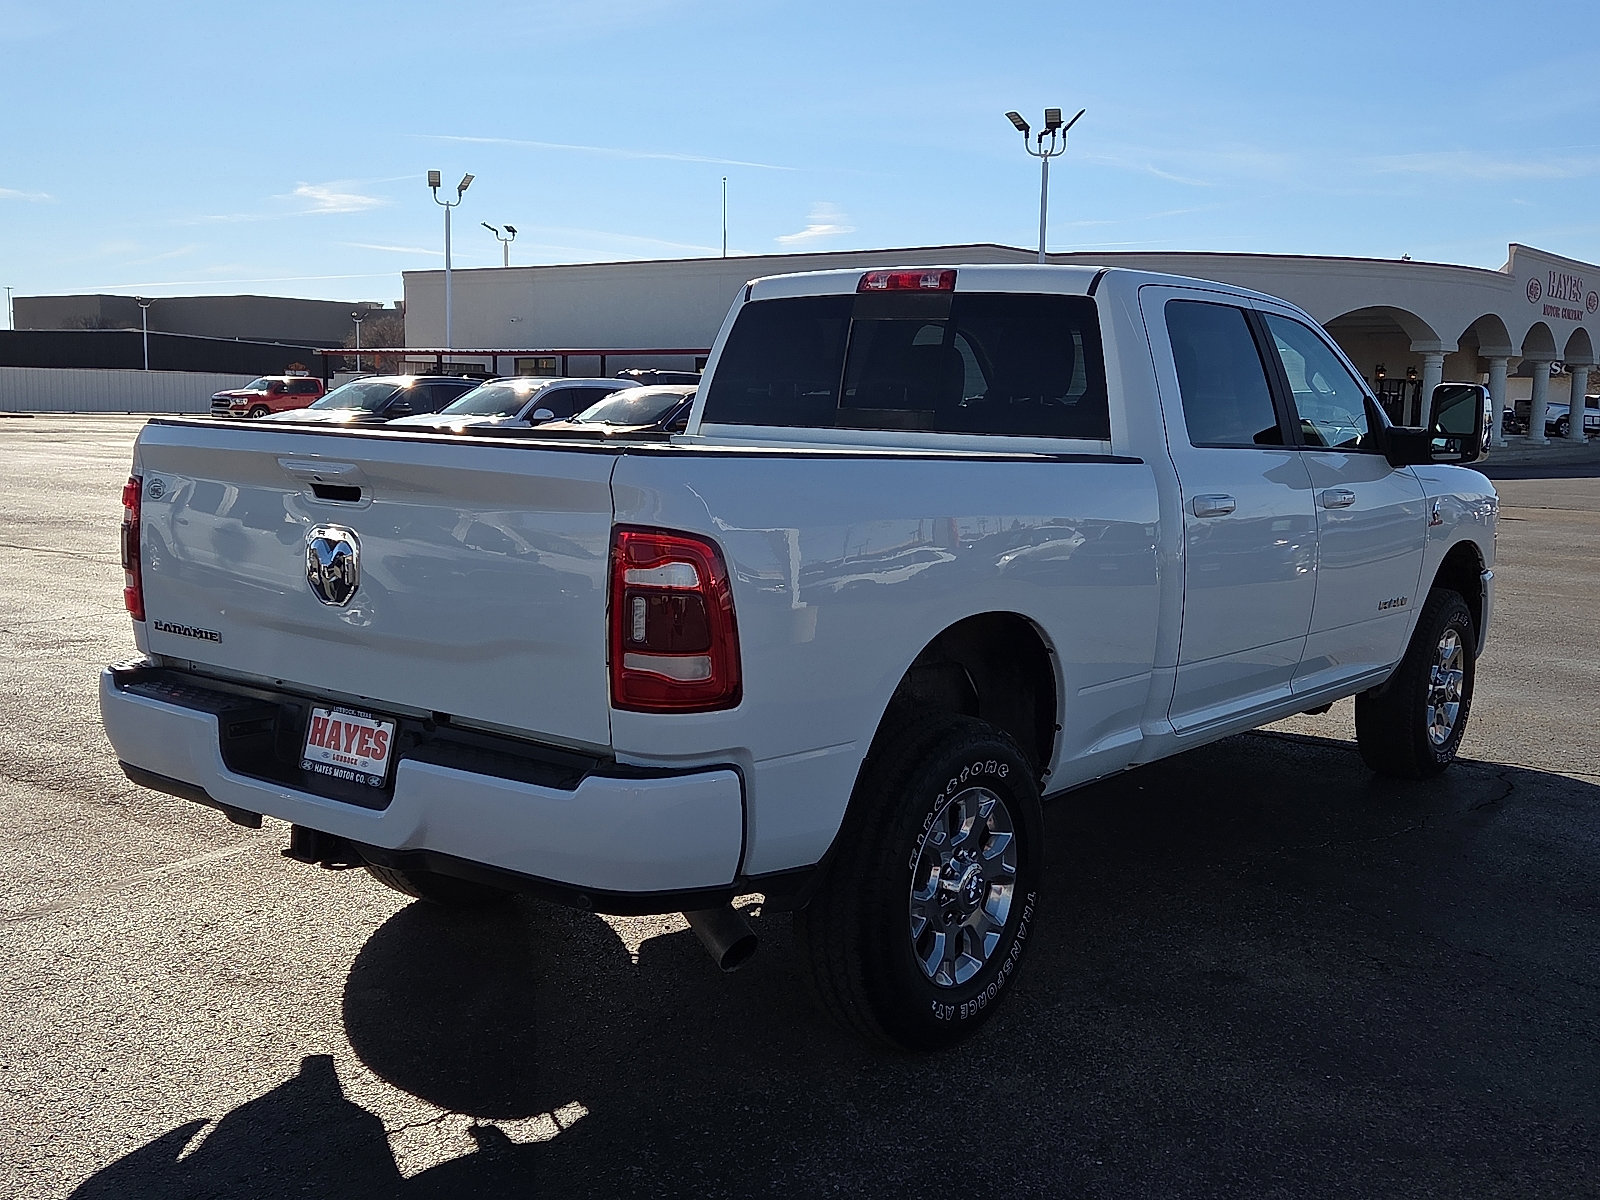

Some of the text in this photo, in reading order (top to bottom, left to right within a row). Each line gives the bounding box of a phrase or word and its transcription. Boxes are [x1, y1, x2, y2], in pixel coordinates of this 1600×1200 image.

[1547, 270, 1583, 302] HAYES
[153, 619, 222, 643] LARAMIE
[357, 711, 372, 719] TEXAS
[308, 716, 389, 761] HAYES
[332, 753, 359, 766] LUBBOCK
[314, 763, 333, 775] HAYES
[333, 768, 354, 781] MOTOR
[355, 773, 366, 784] CO.
[960, 891, 1037, 1020] TRANSFORCE
